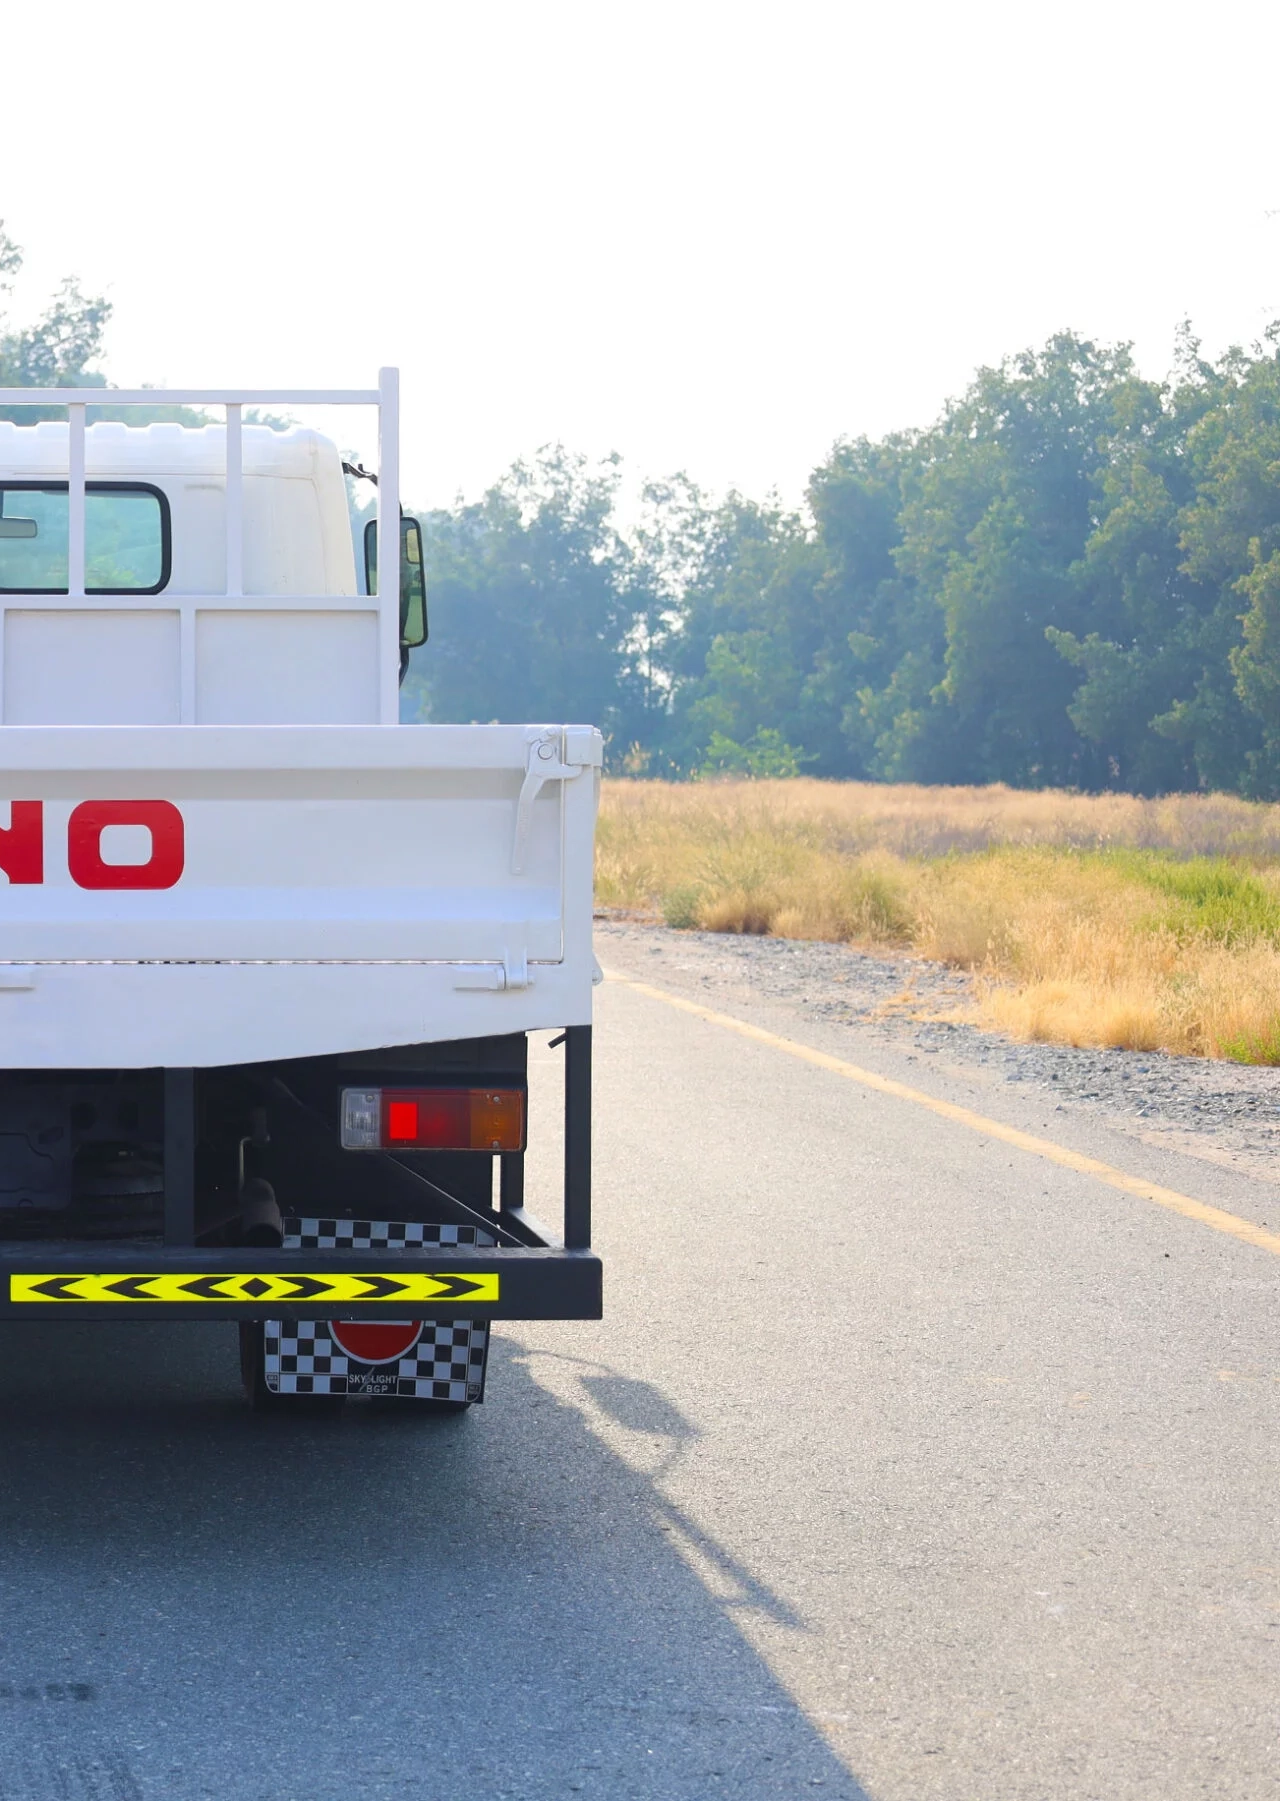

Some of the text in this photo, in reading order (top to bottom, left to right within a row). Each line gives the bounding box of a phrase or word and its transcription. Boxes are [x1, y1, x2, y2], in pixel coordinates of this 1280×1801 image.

[349, 1374, 397, 1384] SKY LIGHT
[366, 1384, 388, 1393] BGP
